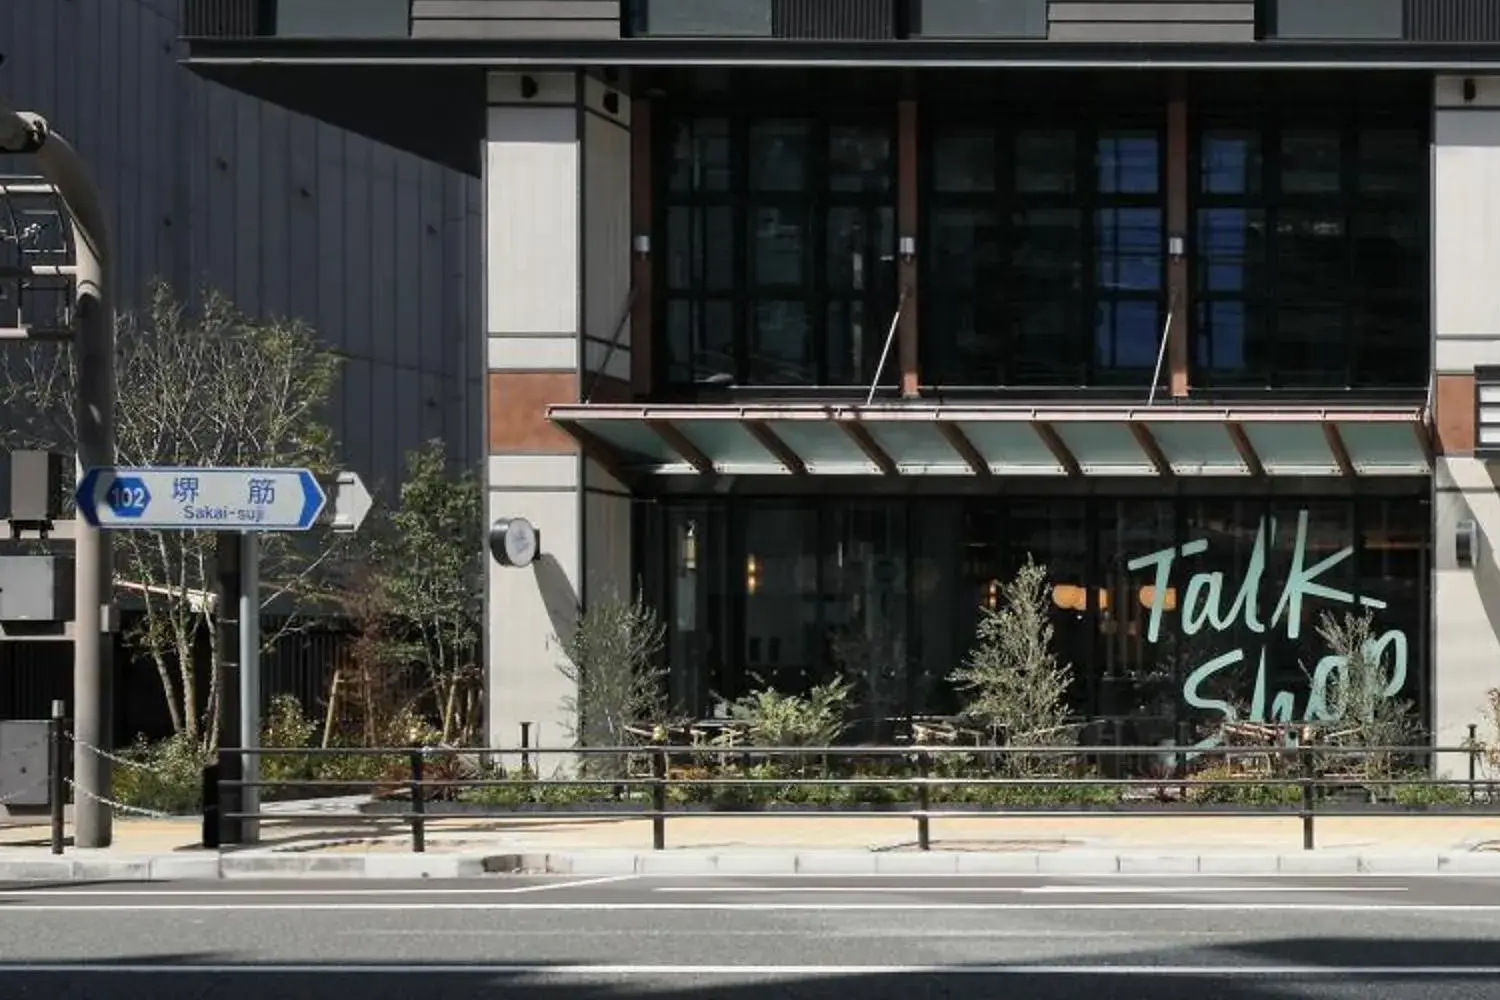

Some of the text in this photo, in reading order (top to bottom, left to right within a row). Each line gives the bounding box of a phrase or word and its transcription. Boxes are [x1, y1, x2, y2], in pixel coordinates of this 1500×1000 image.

[111, 487, 144, 506] 102
[183, 505, 264, 522] Sakai-suji
[1127, 510, 1387, 643] Talk
